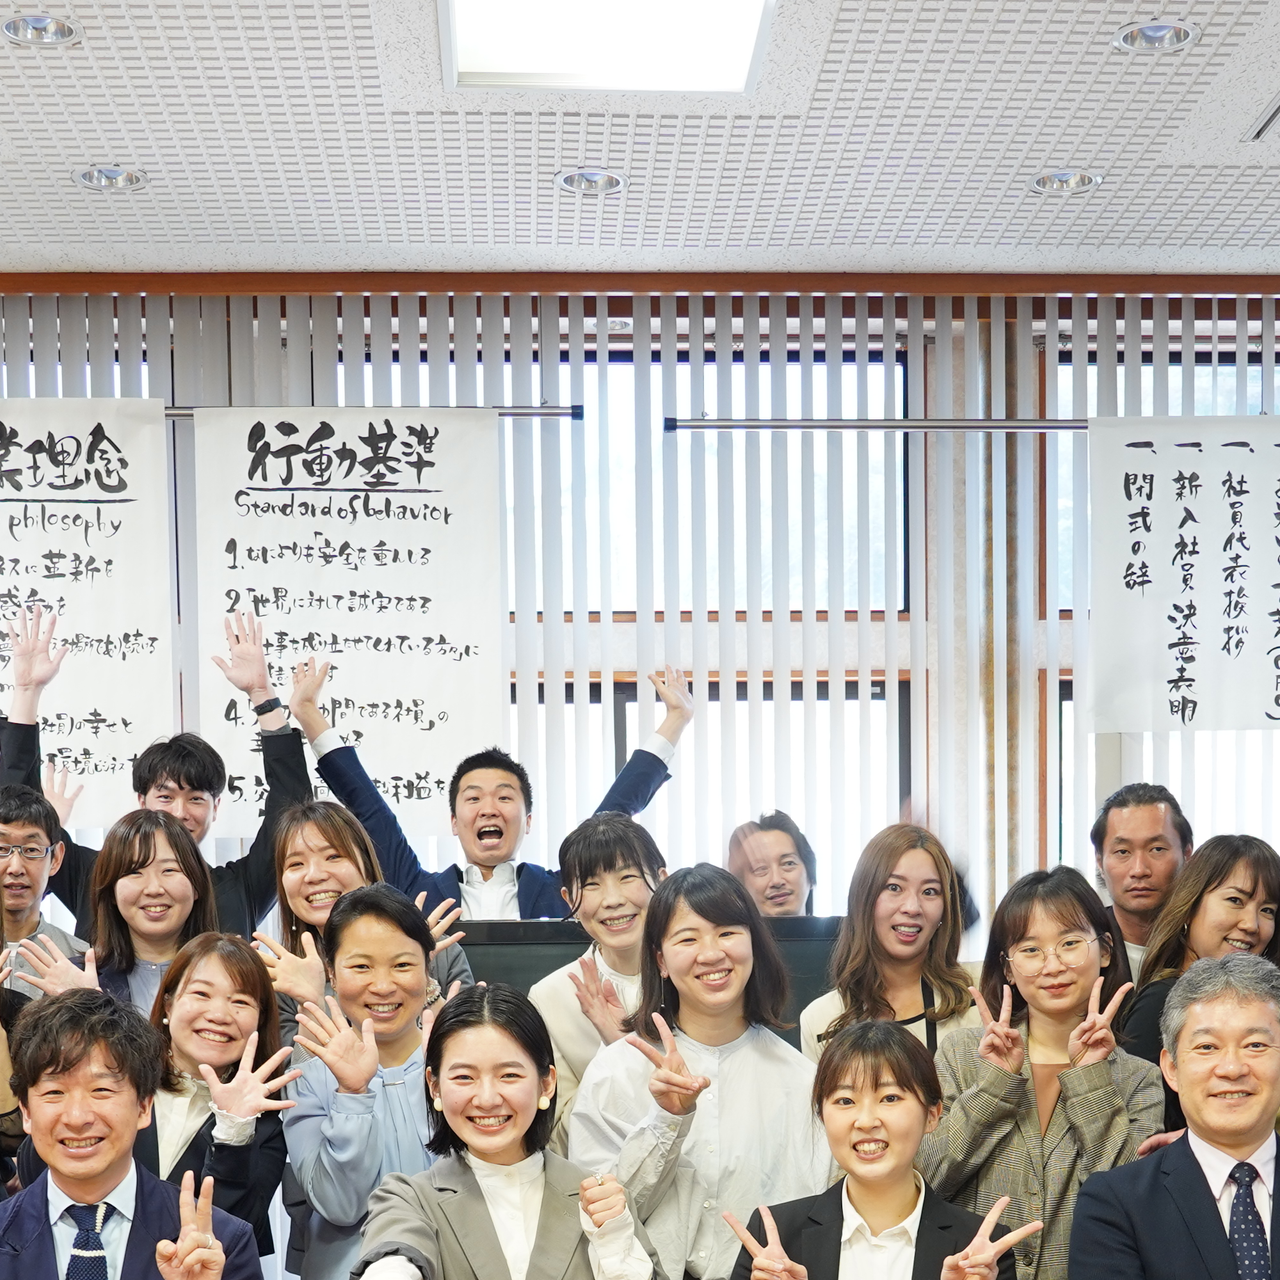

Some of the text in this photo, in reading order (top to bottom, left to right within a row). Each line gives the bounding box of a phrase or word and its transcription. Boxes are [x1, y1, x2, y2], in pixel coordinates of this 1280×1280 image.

[247, 418, 439, 488] 行動基準
[8, 503, 121, 547] philosophy
[234, 490, 453, 525] Standard of behavior
[1167, 441, 1203, 726] 一、新入社員決意表明
[1220, 441, 1255, 659] 一、社員代表挨拶
